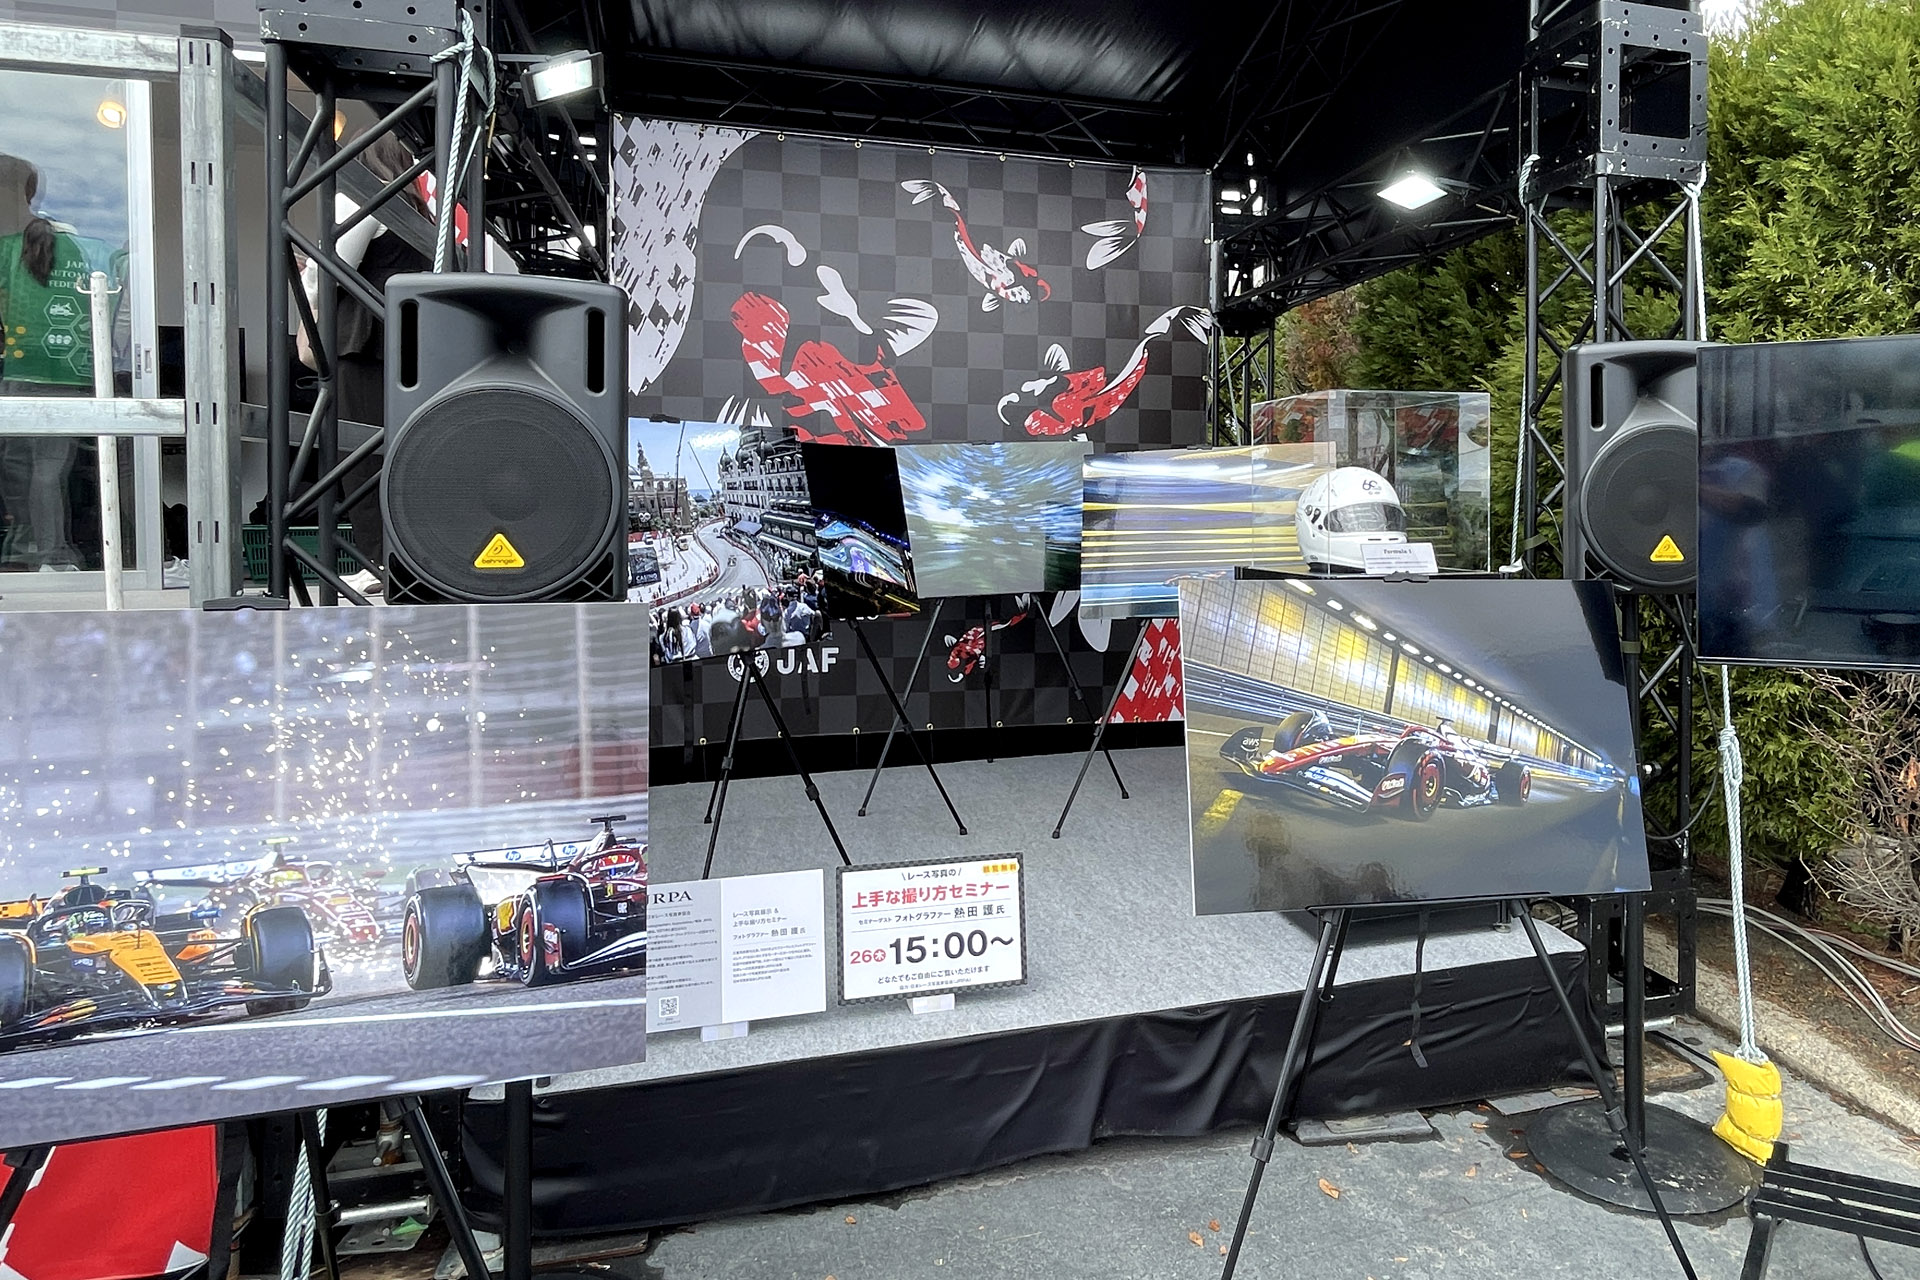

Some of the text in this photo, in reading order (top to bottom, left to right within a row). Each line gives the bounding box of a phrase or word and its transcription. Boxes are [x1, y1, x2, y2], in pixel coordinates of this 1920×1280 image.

[777, 647, 840, 675] JAF
[1242, 736, 1260, 747] aws
[852, 881, 1010, 909] 上手な撮り方セミナー
[895, 911, 951, 923] フォトグラファー
[878, 965, 991, 984] どなたでもご自由にご覧いただけます
